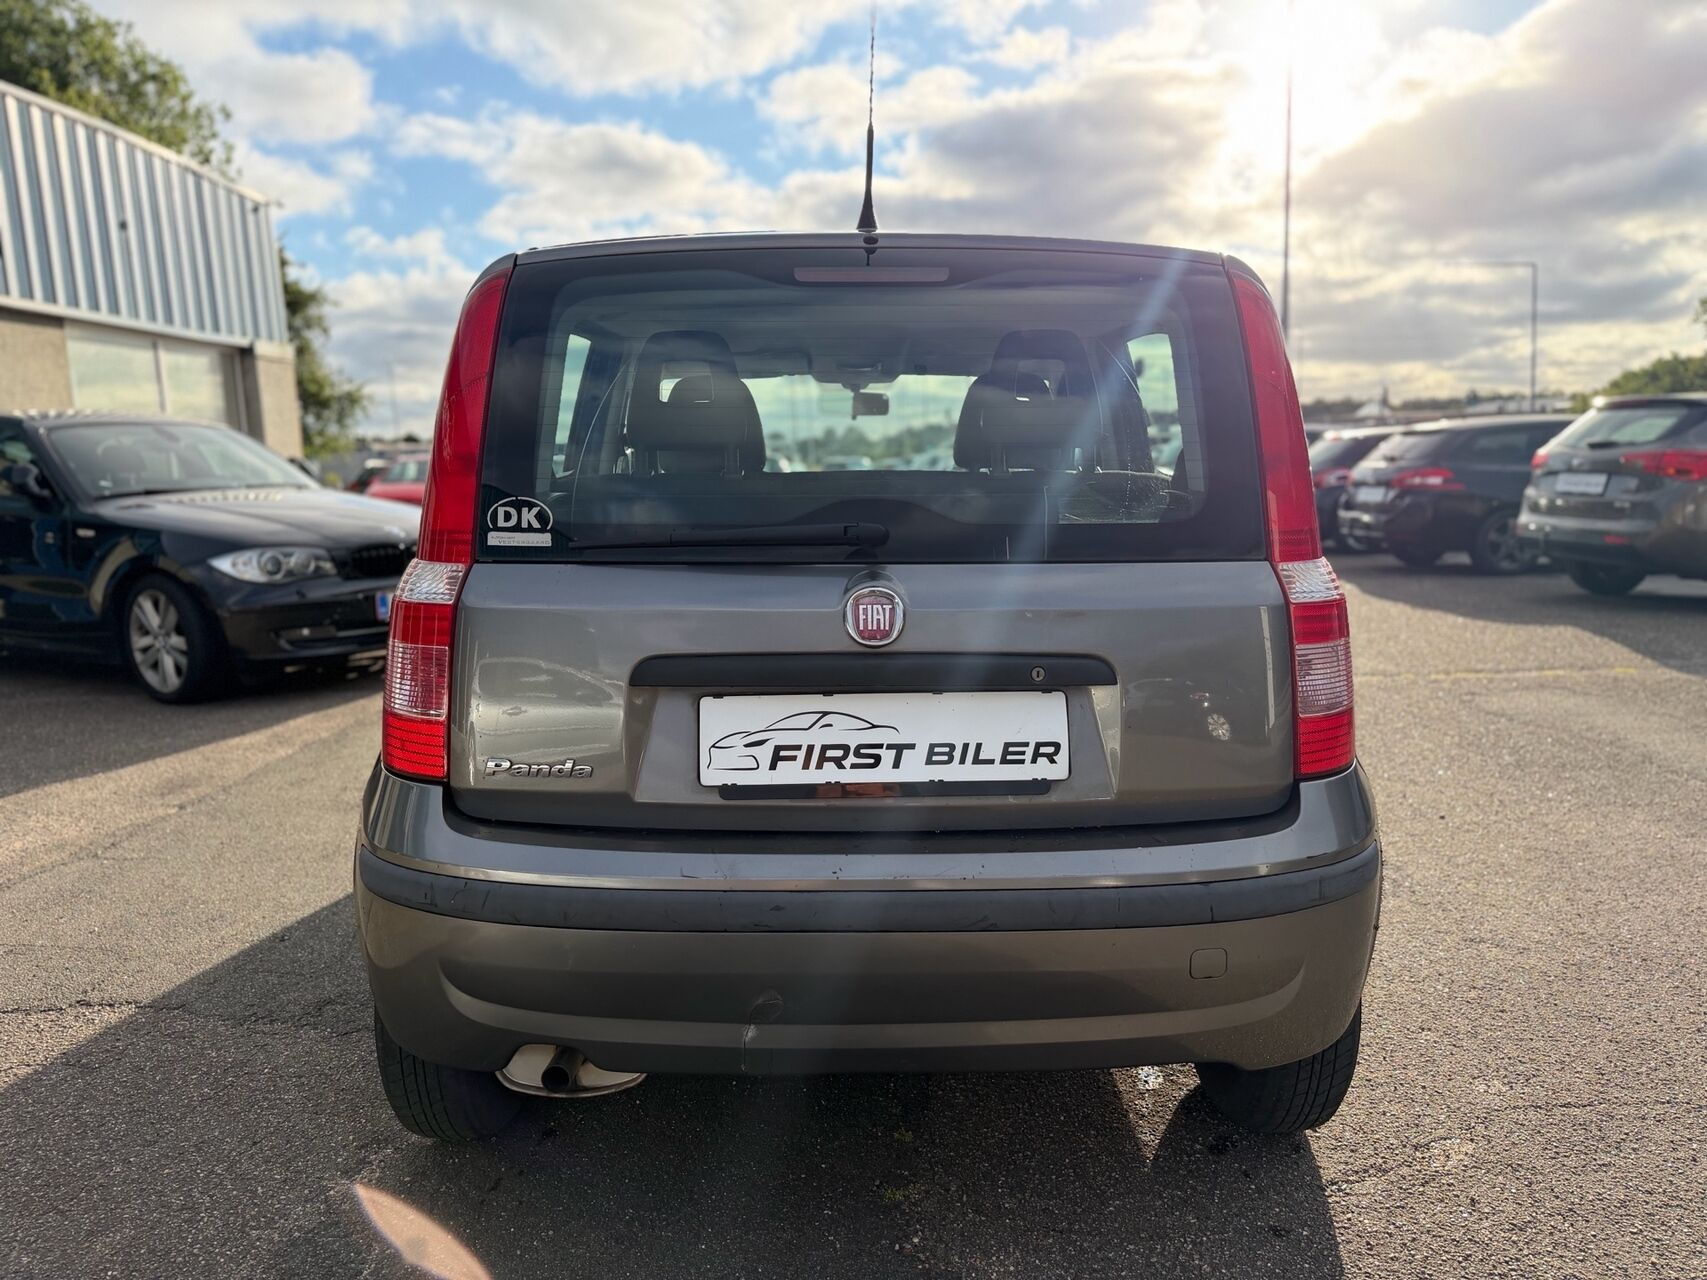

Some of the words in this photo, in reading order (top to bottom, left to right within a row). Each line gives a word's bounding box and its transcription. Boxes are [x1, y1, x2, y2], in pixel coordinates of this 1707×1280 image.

[497, 506, 541, 528] DK
[859, 604, 892, 630] FIAT
[485, 758, 592, 777] Panda
[768, 743, 916, 771] FIRST
[925, 740, 1062, 766] BILER
